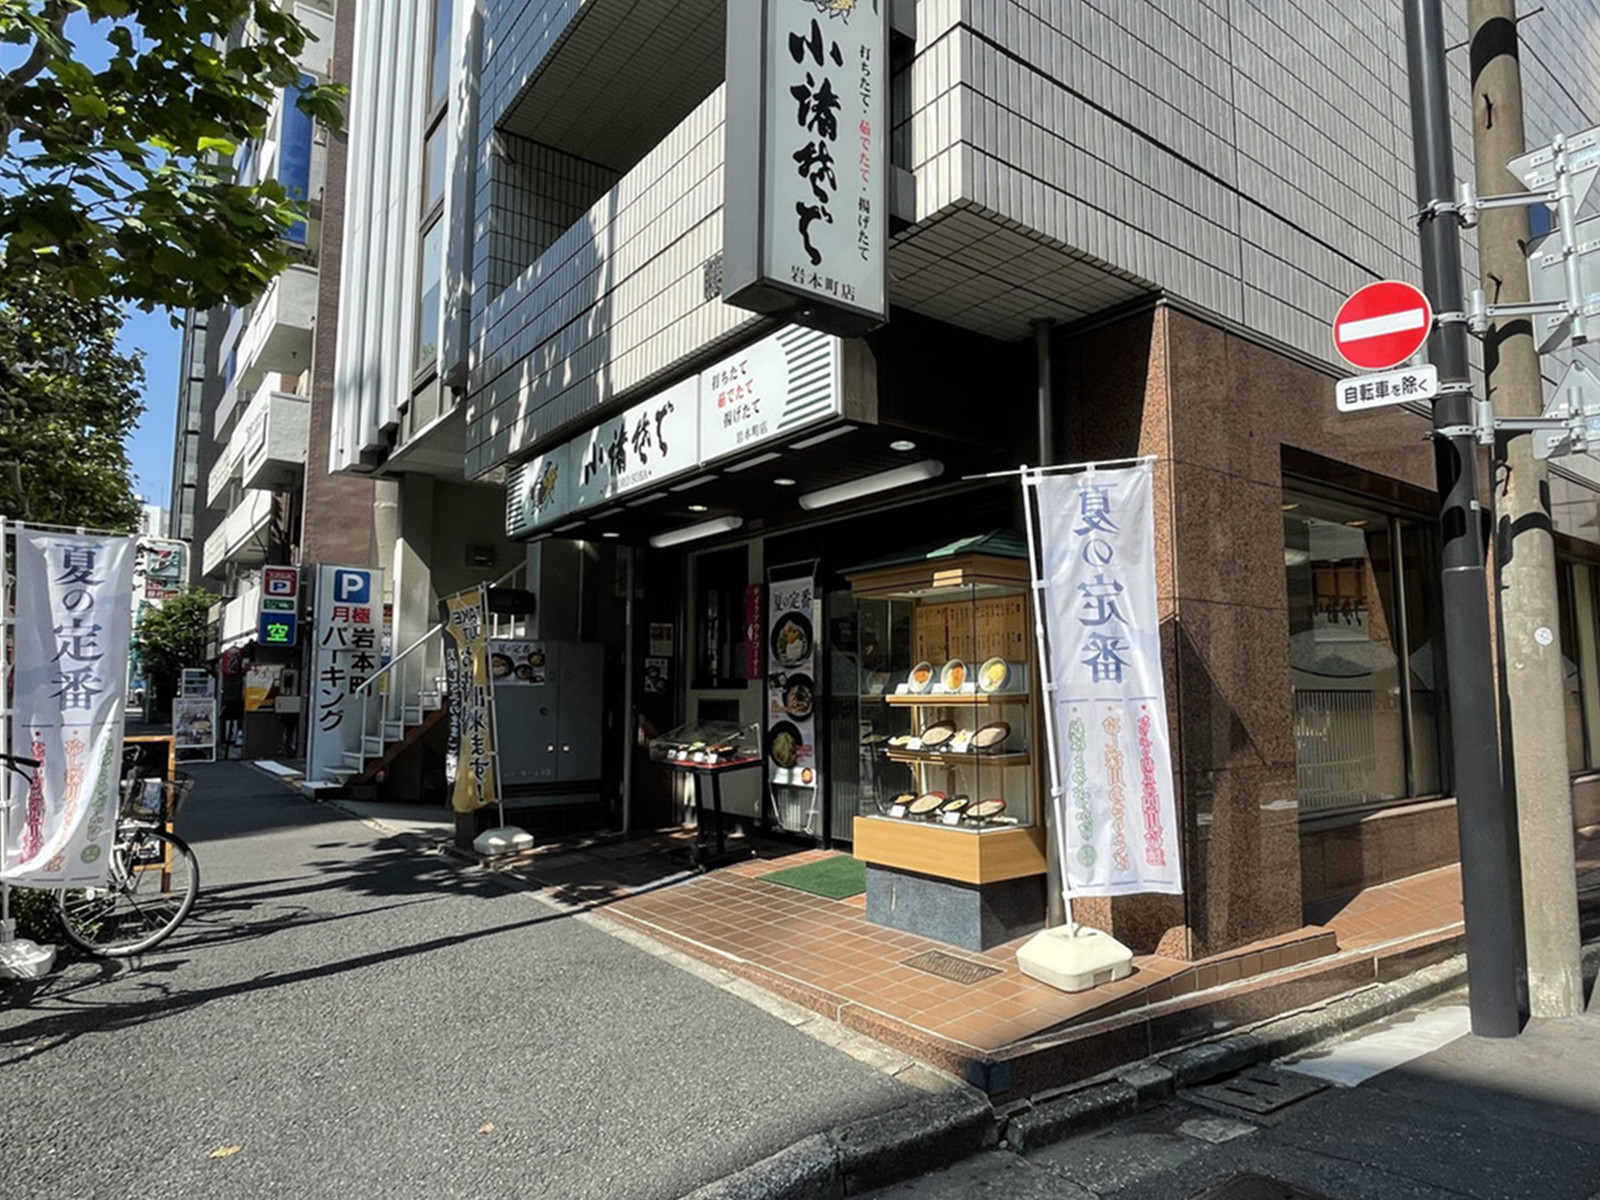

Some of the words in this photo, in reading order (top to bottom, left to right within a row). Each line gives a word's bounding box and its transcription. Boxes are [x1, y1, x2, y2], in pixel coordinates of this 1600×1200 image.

[790, 265, 856, 301] 岩本町店
[711, 360, 748, 391] 打ちたて
[1344, 375, 1428, 405] 自転車を除く
[723, 398, 761, 429] 揚げたて
[736, 421, 768, 443] 岩本町店
[271, 580, 287, 592] P
[341, 573, 365, 600] P
[773, 588, 812, 611] 夏の定番
[50, 543, 104, 711] 夏の定番
[331, 606, 371, 624] 月極
[266, 622, 289, 642] 空
[350, 627, 375, 698] 岩本町
[319, 626, 349, 732] パーキング
